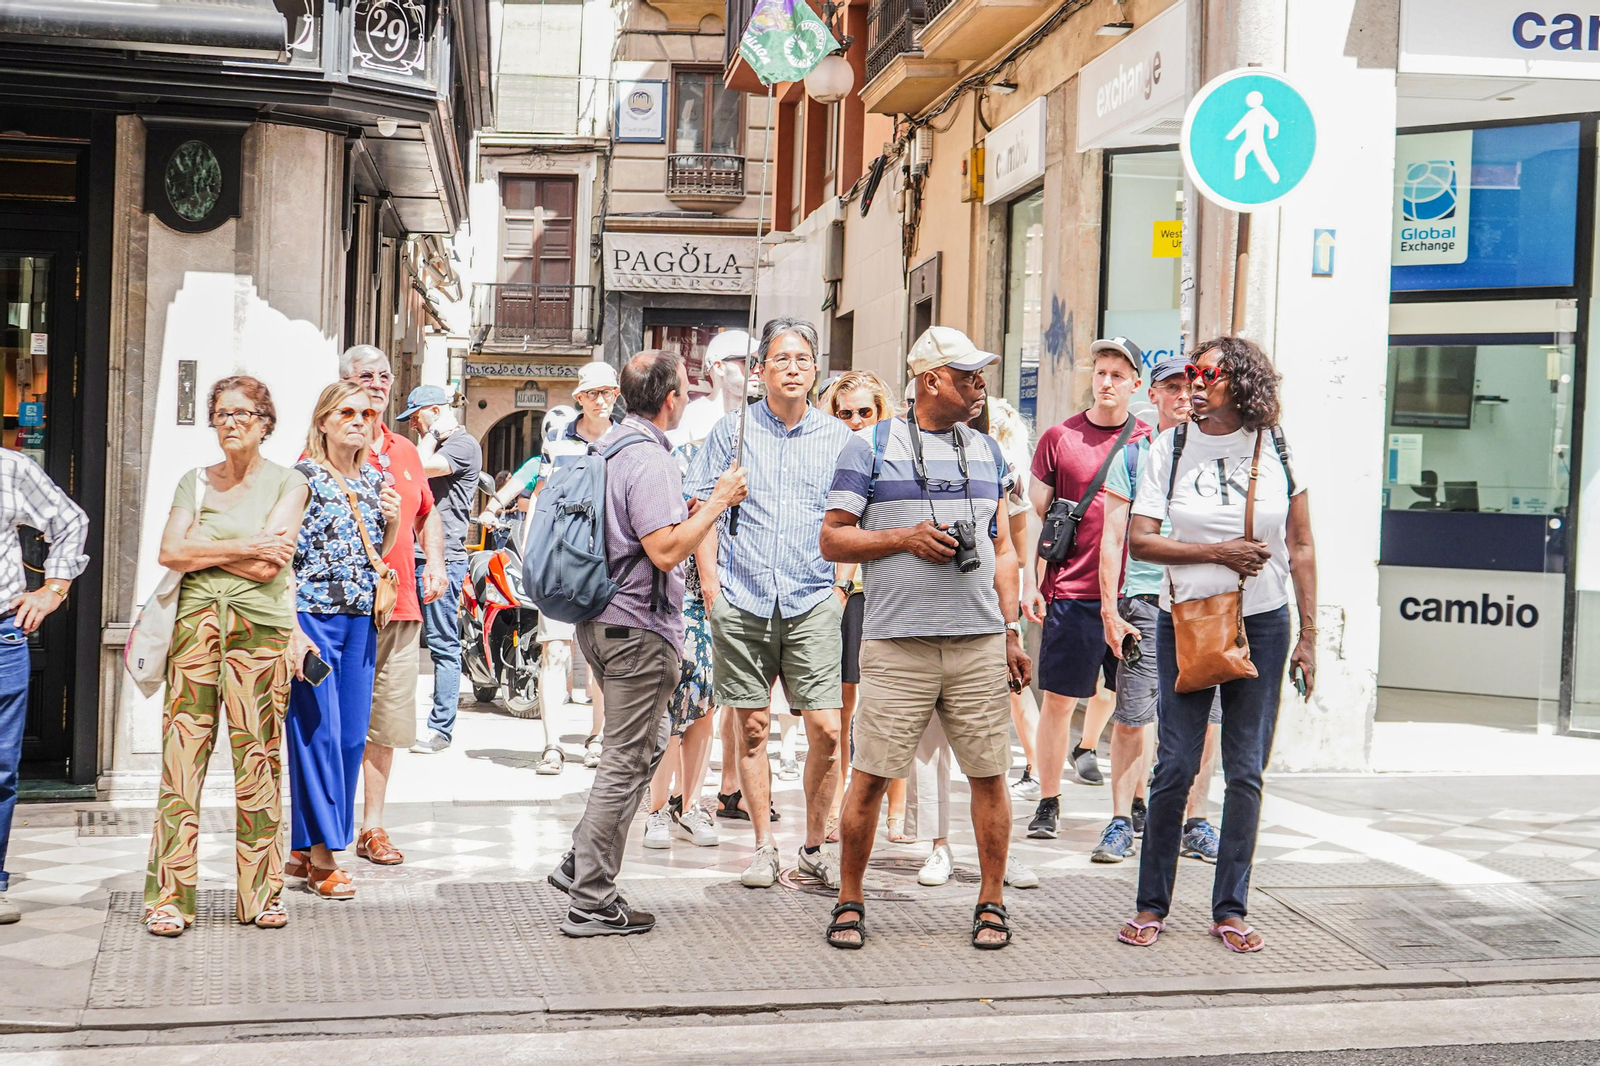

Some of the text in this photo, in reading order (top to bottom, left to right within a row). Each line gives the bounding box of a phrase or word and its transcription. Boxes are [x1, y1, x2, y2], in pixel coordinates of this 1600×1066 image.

[370, 9, 406, 52] 29
[1096, 51, 1162, 118] exchange
[1400, 241, 1456, 253] Exchange
[1401, 226, 1456, 240] Global
[1399, 592, 1540, 629] cambio
